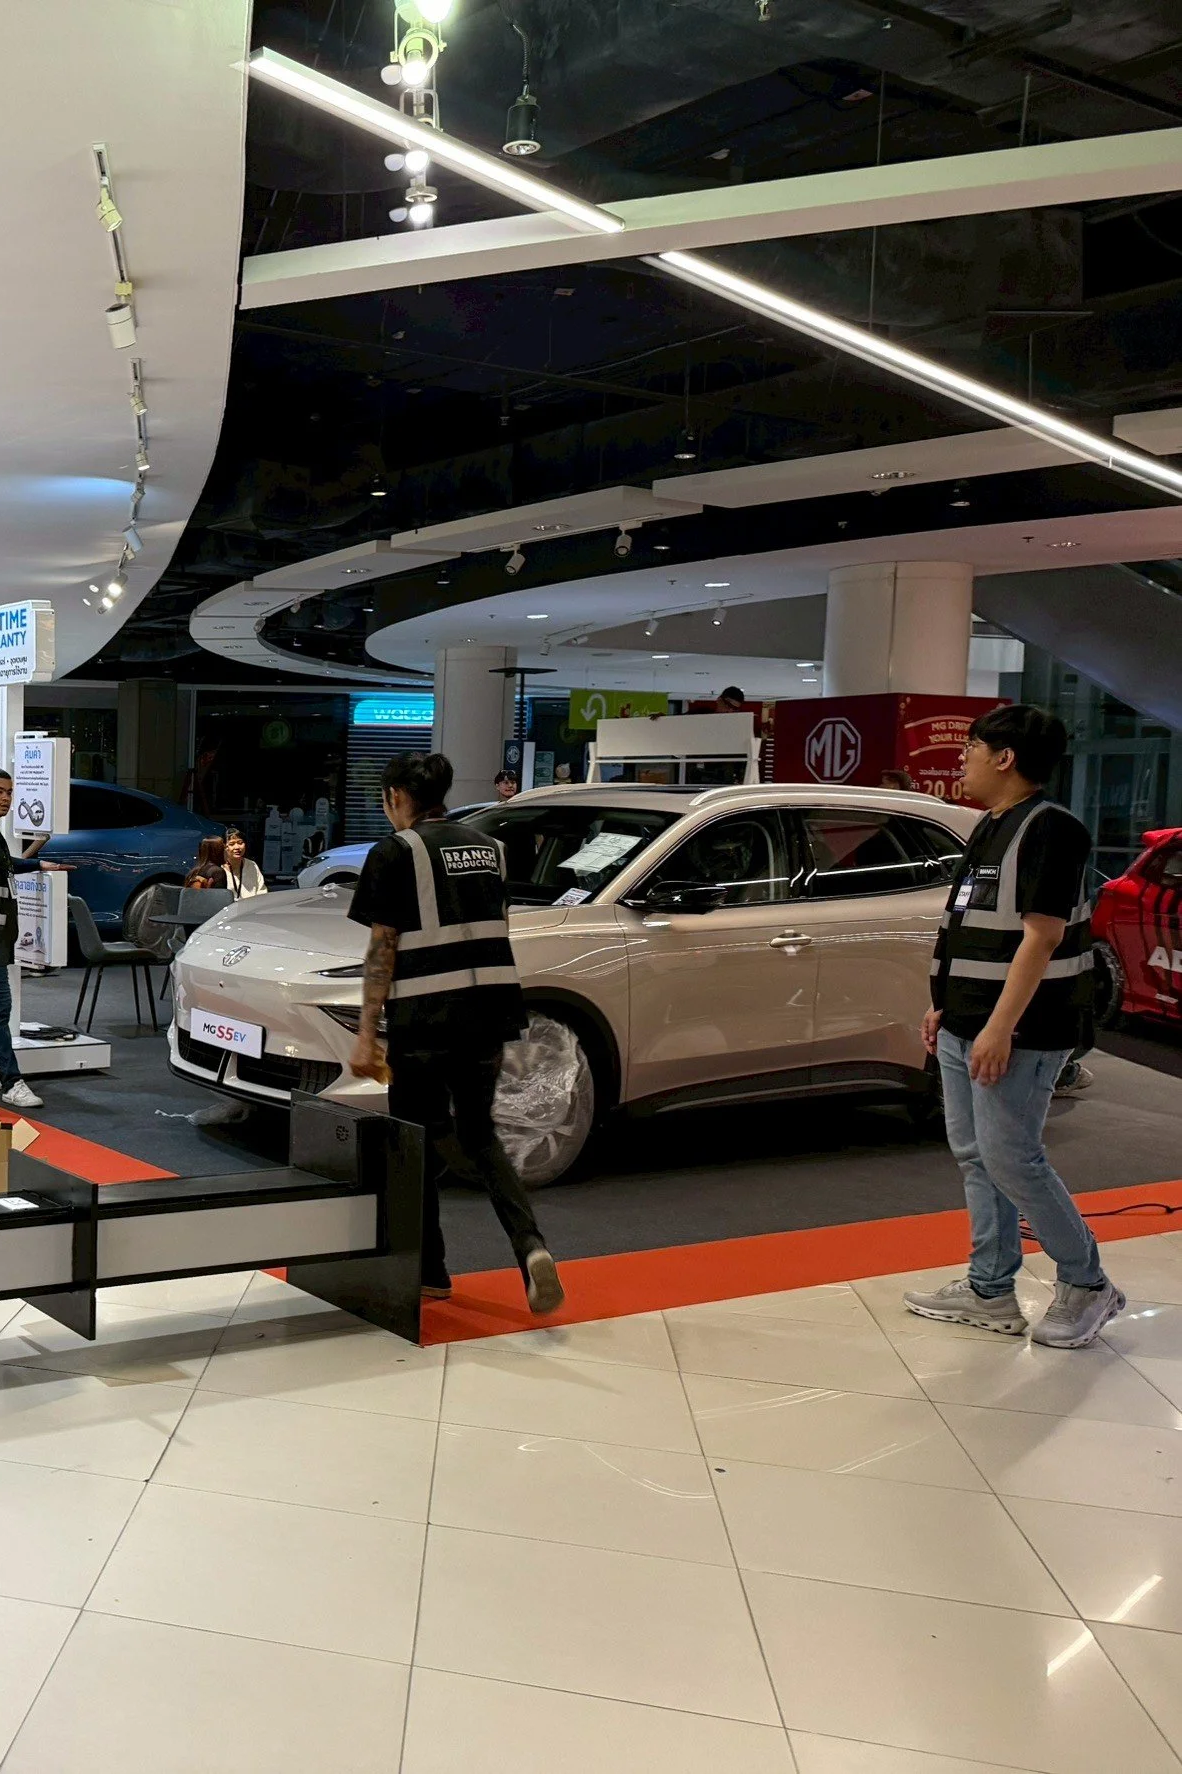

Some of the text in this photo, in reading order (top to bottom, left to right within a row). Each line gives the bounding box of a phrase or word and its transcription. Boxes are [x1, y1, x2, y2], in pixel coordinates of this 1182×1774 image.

[808, 721, 859, 780] MG
[444, 849, 496, 862] BRANCH
[202, 1022, 247, 1042] MG S5 EV
